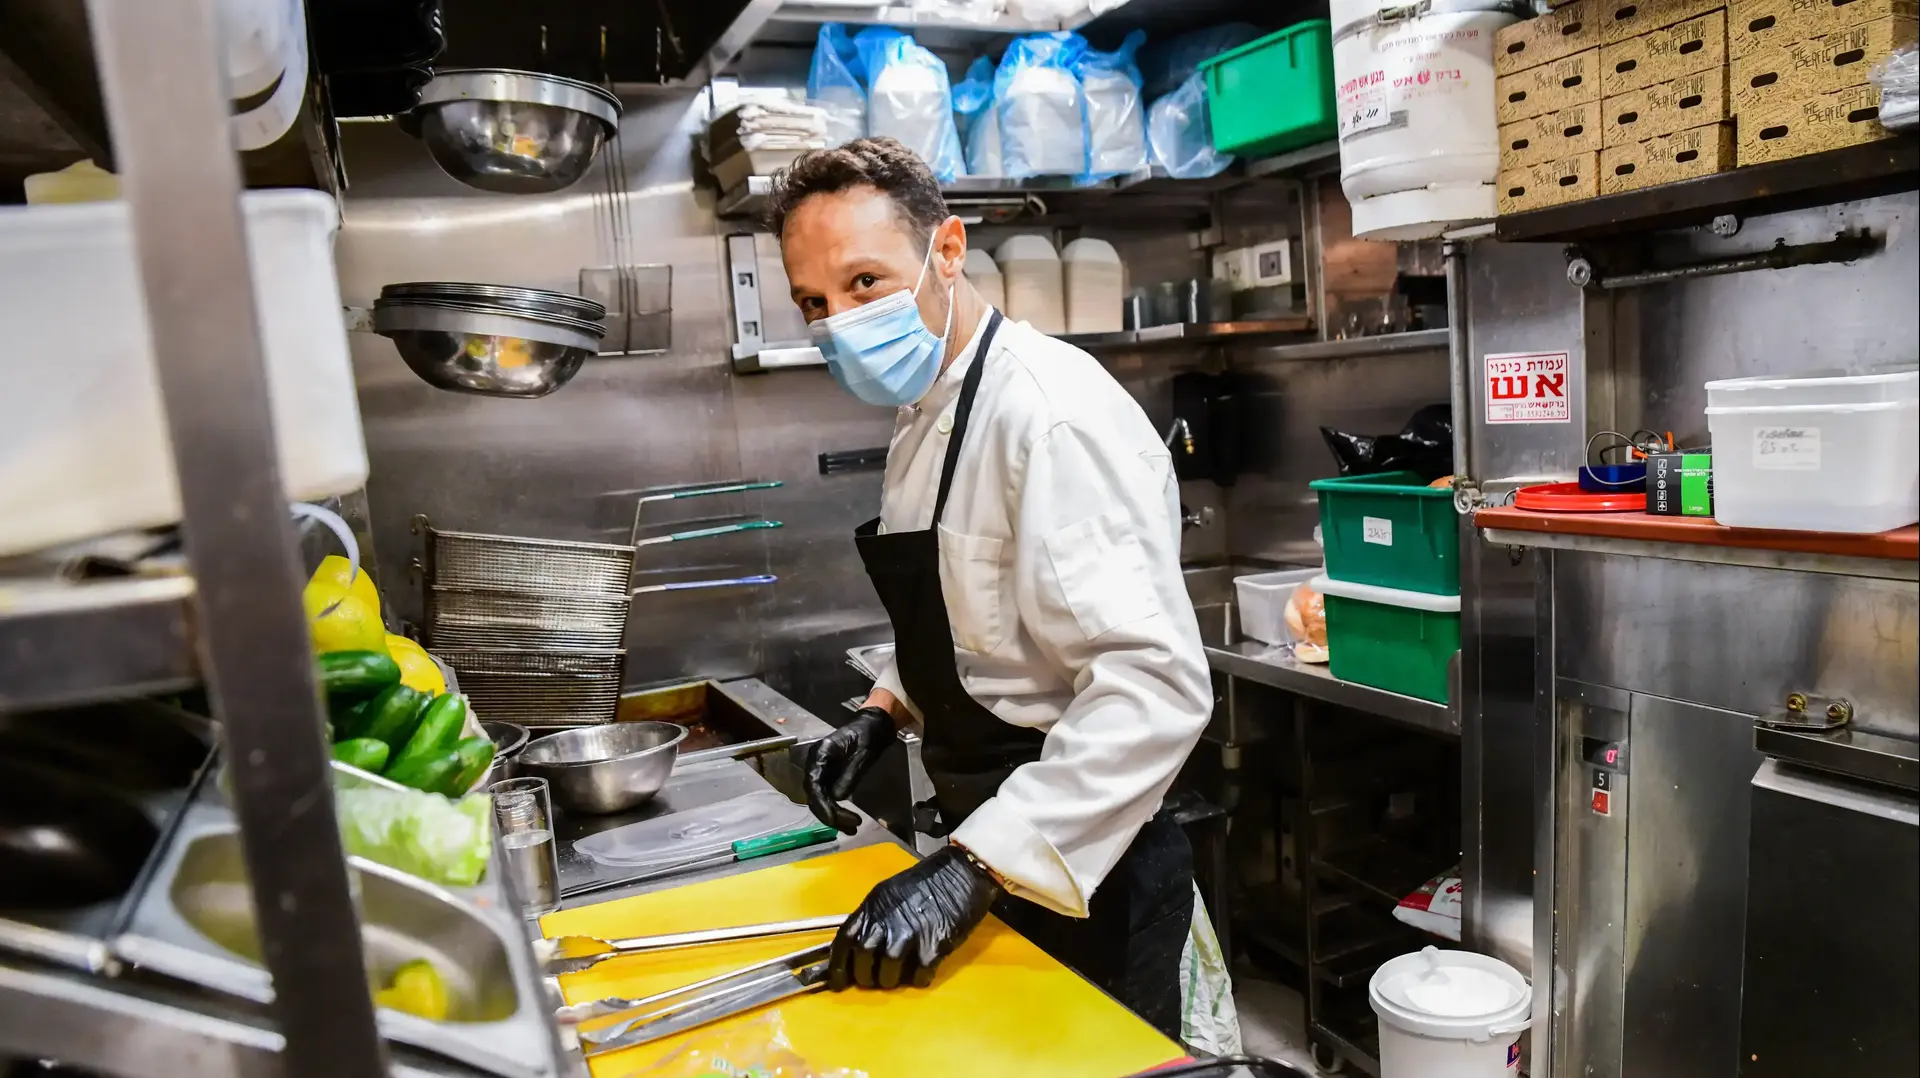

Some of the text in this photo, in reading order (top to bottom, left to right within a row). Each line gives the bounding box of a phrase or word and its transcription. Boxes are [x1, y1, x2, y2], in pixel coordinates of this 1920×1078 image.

[1791, 46, 1807, 60] THE
[1795, 43, 1843, 71] PERFECT
[1843, 26, 1869, 51] FRIES!
[1803, 100, 1819, 115] THE
[1807, 99, 1856, 126] PERFECT
[1490, 359, 1563, 373] עמדת כיבוי
[1490, 373, 1564, 399] אש
[1598, 772, 1605, 787] 5
